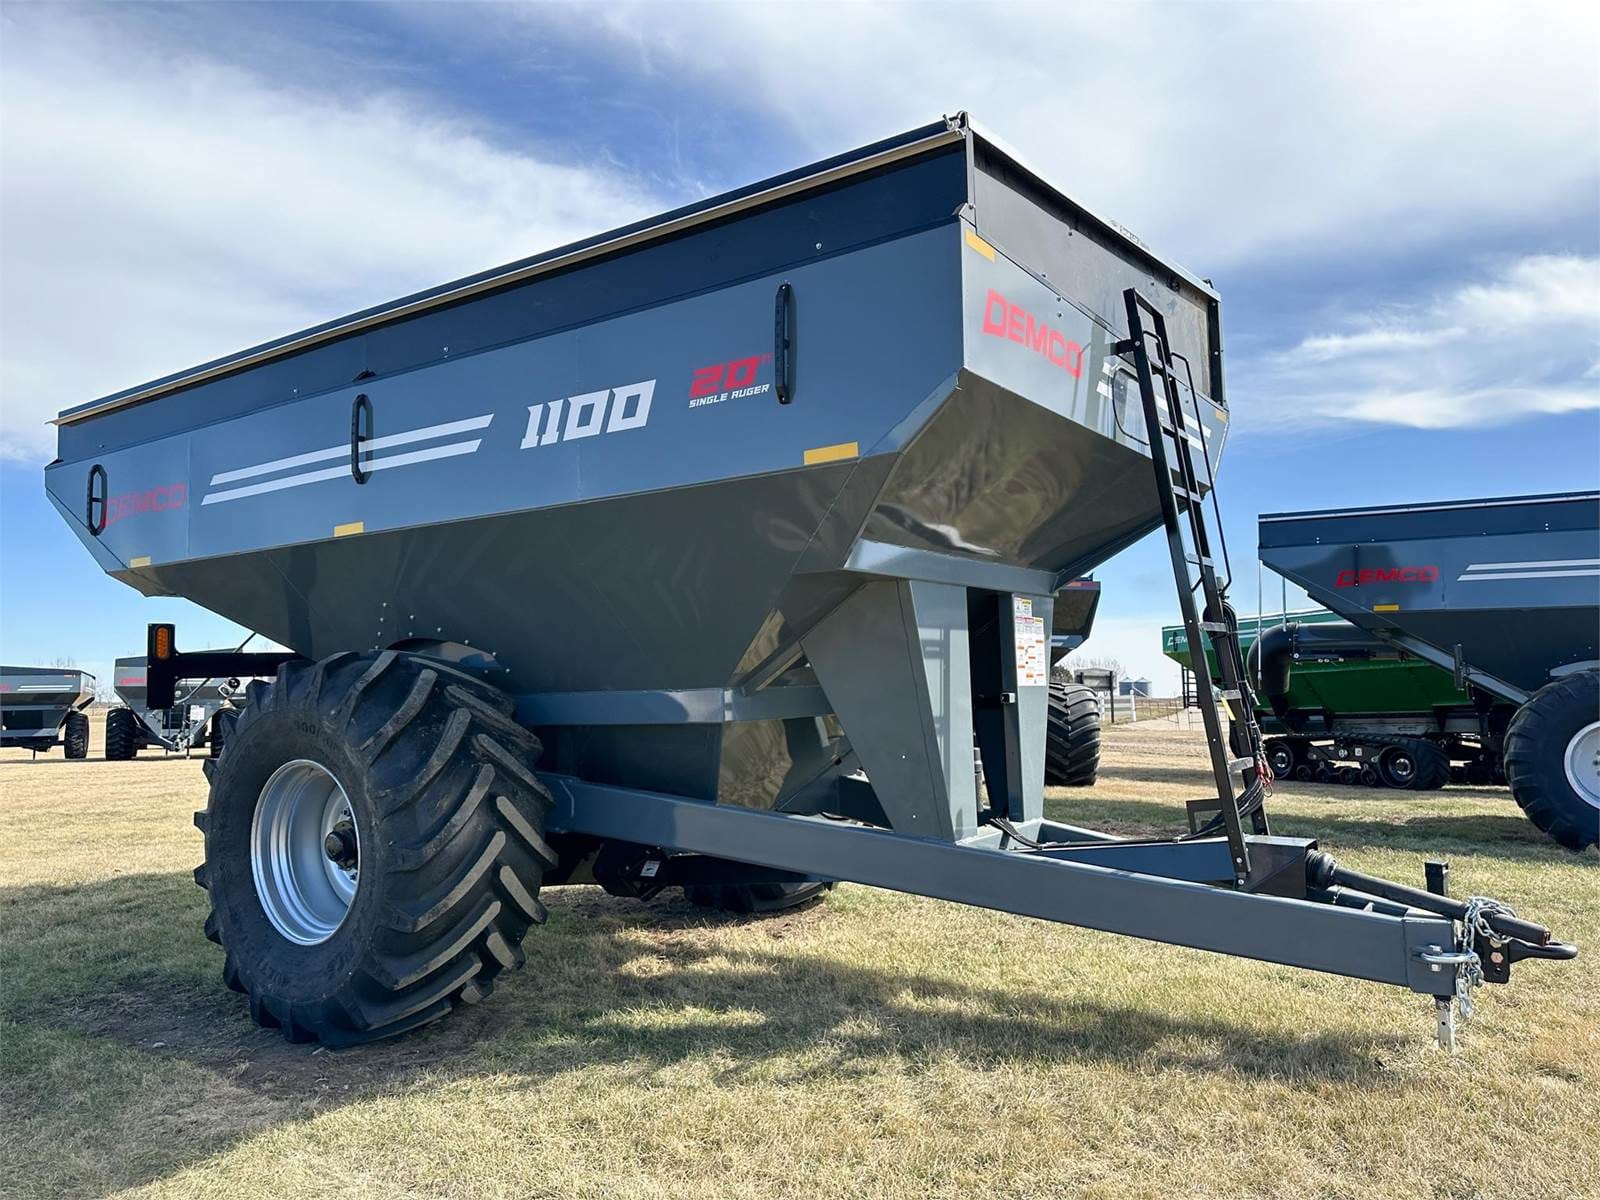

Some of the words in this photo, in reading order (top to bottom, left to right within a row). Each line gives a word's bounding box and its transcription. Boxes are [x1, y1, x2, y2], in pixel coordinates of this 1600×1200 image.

[983, 288, 1083, 380] DEMCO
[520, 379, 656, 450] 1100
[688, 392, 728, 408] SINGLE
[731, 383, 770, 400] AUGER
[102, 483, 187, 528] DEMCO
[1335, 565, 1440, 588] DEMCO
